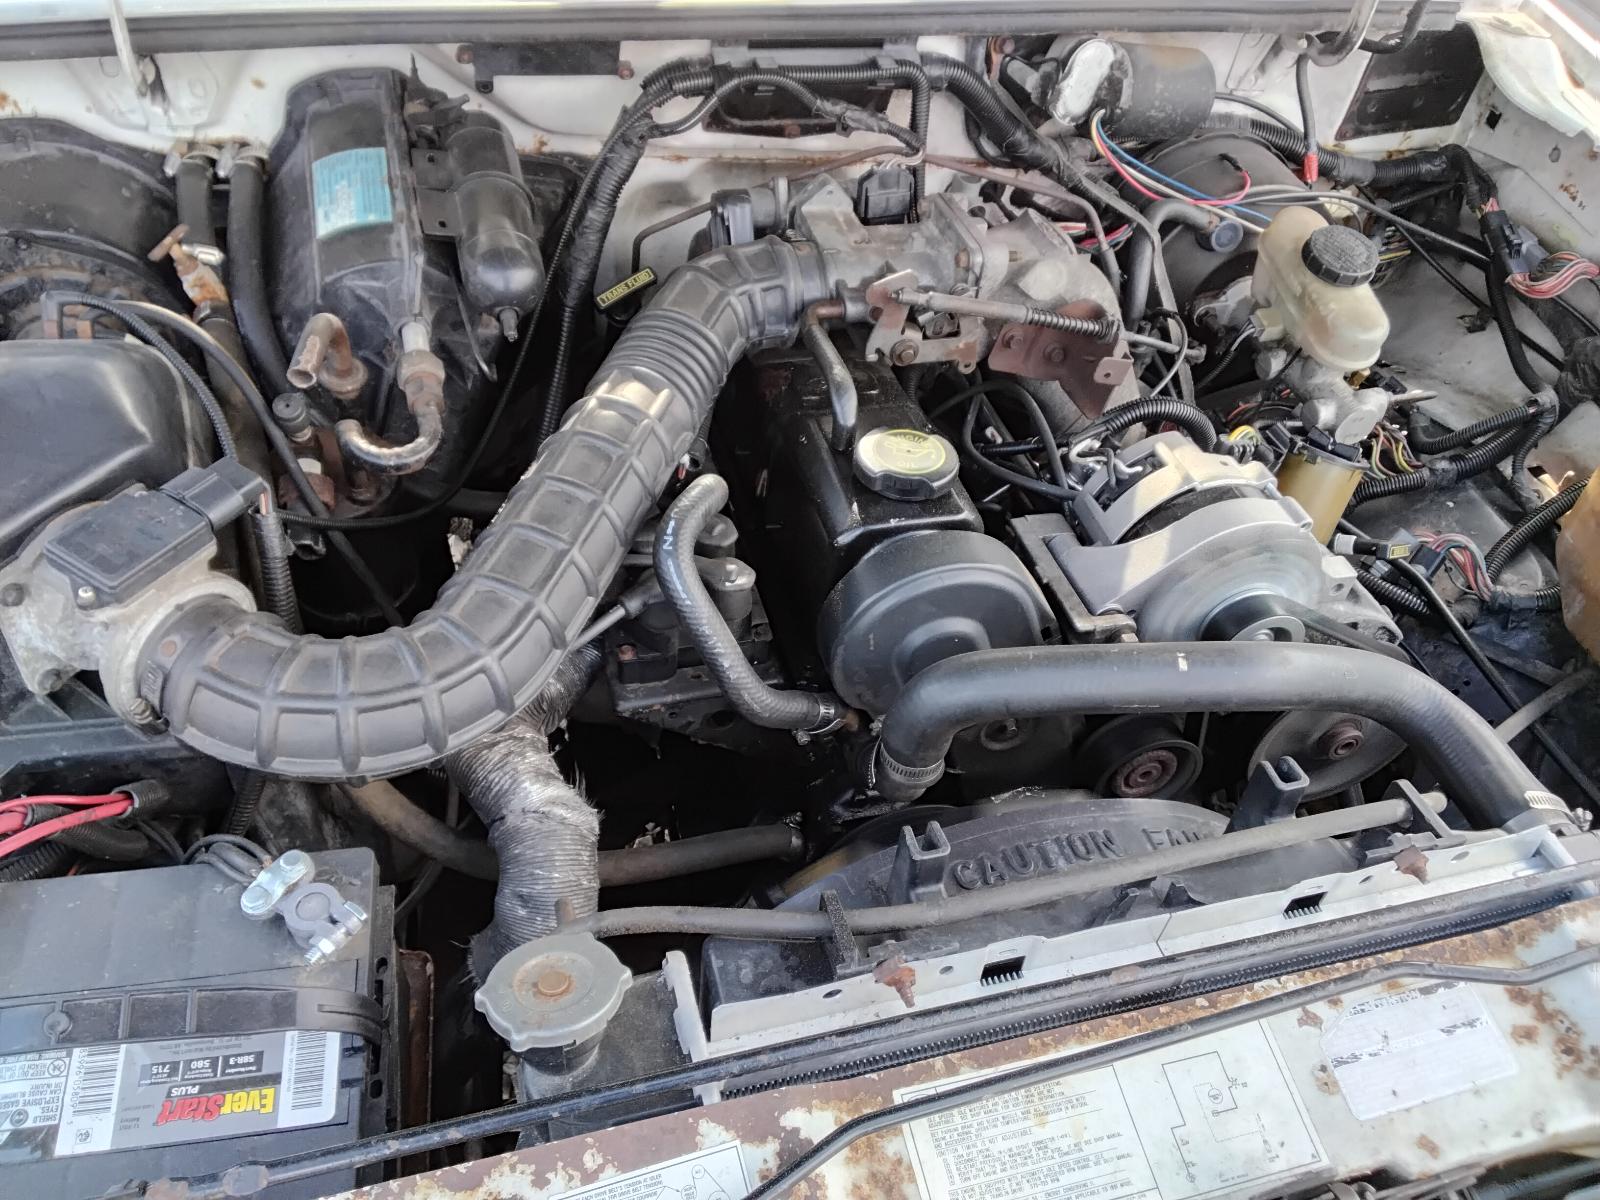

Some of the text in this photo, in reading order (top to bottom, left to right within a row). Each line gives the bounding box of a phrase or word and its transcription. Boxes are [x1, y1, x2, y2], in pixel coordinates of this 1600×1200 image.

[602, 271, 651, 302] TRANS FLUID
[953, 828, 1124, 890] CAUTION
[151, 1062, 171, 1075] 715
[190, 1058, 211, 1071] 580
[171, 1083, 200, 1097] PLUS
[21, 1094, 59, 1107] EXPLOSIVE
[155, 1087, 275, 1126] EverStart
[31, 1113, 58, 1124] SHIELD
